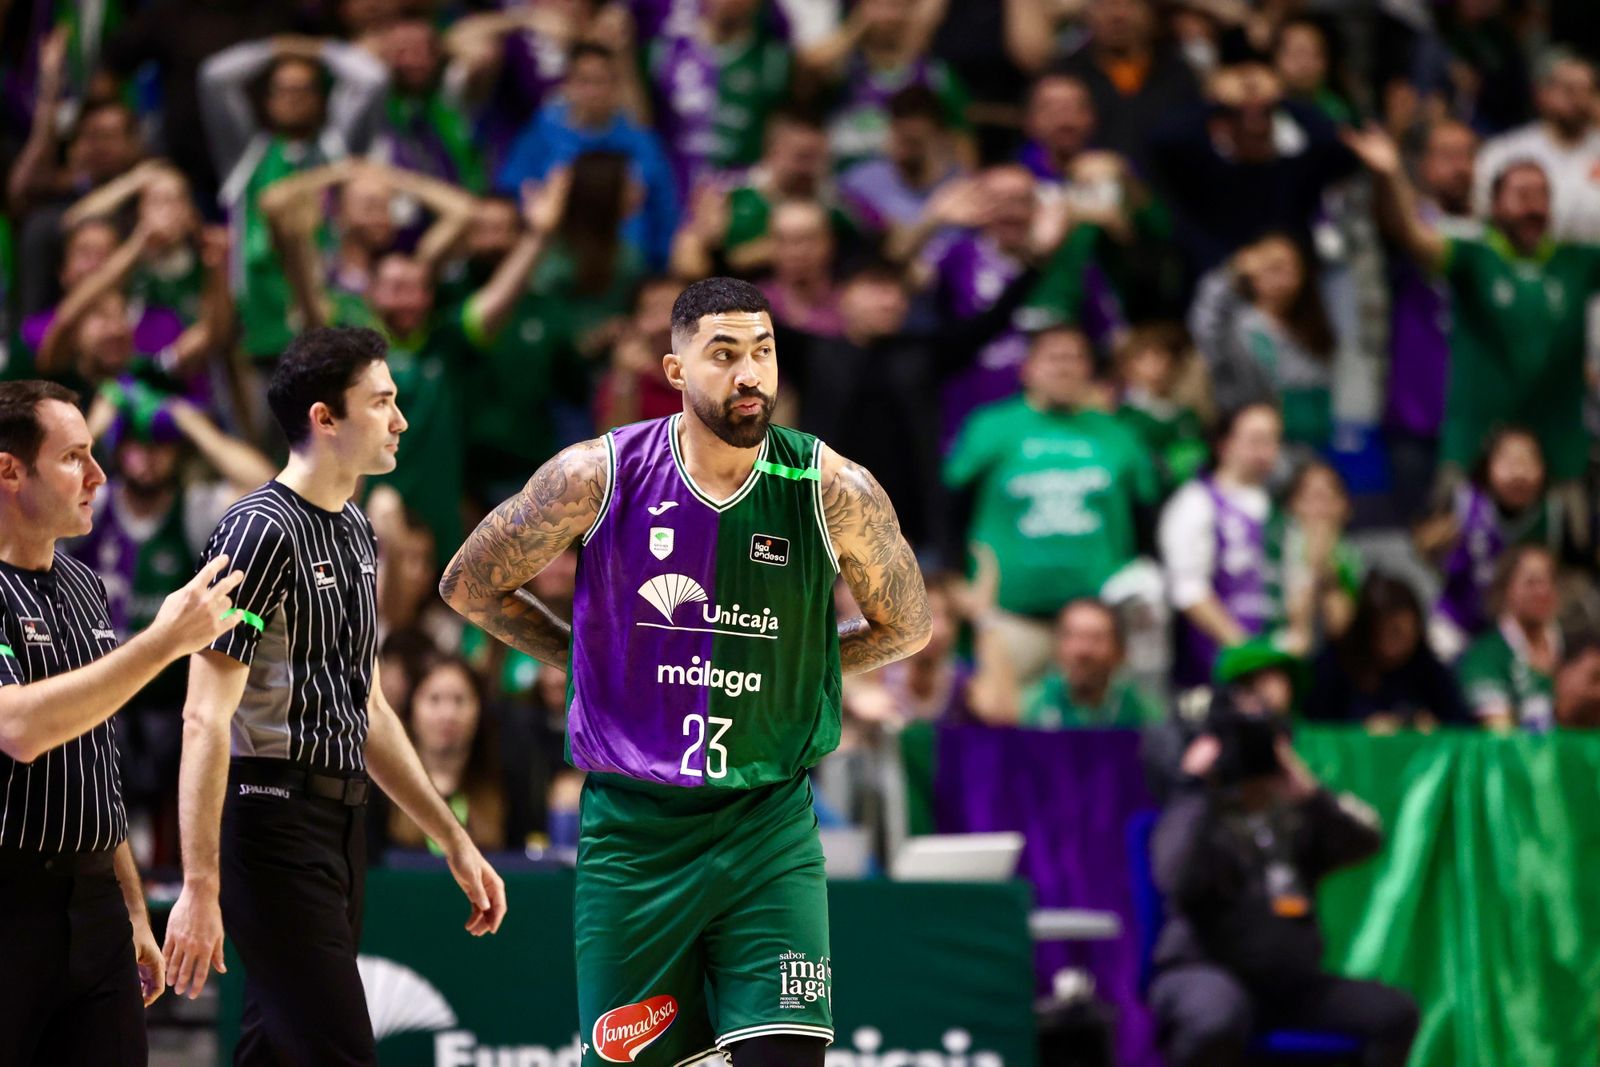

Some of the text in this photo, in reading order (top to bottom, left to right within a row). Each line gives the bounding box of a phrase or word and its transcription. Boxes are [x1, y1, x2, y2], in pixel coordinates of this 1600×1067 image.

[754, 551, 785, 562] endesa
[702, 603, 779, 634] Unicaja
[657, 656, 762, 698] málaga
[680, 713, 733, 779] 23
[239, 783, 290, 799] SPALDING
[779, 949, 806, 960] sabor
[780, 960, 788, 970] a
[789, 956, 826, 981] má
[780, 972, 826, 1002] laga
[599, 1001, 675, 1051] famadesa
